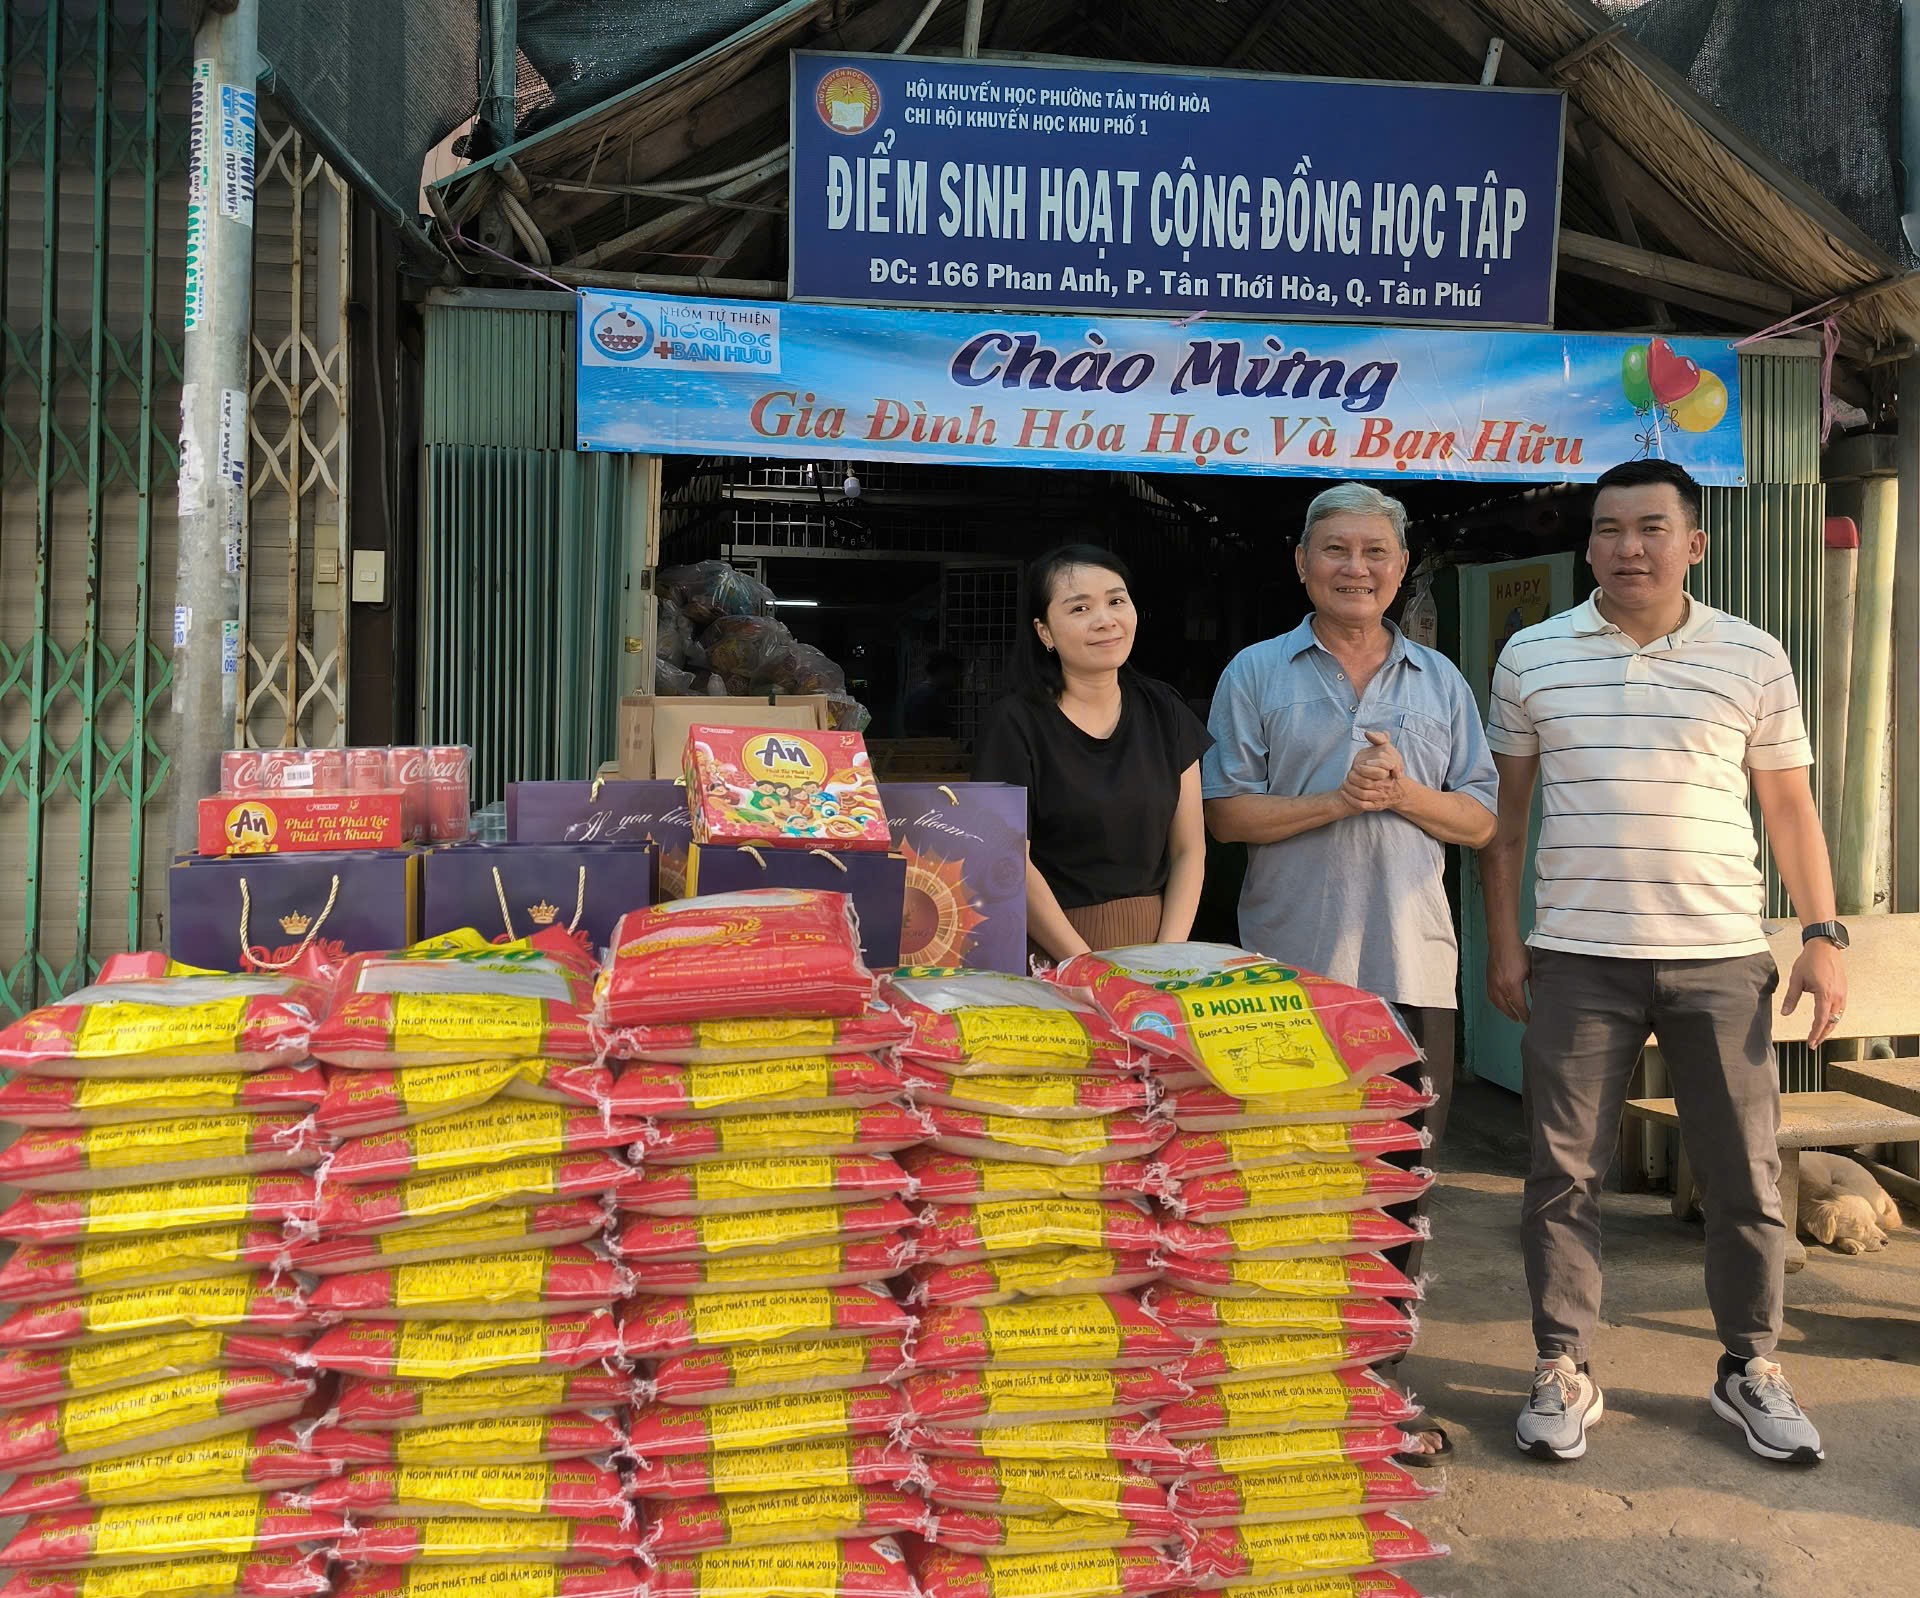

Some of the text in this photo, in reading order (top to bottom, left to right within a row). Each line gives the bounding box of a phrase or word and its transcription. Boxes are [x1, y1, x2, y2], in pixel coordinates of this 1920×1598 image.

[906, 78, 1210, 113] HỘI KHUYẾN HỌC PHƯỜNG TÂN THỚI HÒA
[904, 106, 1148, 135] CHI HỘI KHUYẾN HỌC KHU PHỐ 1
[826, 127, 1527, 275] ĐIỂM SINH HOẠT CỘNG ĐỒNG HỌC TẬP
[869, 257, 1481, 307] ĐC: 166 Phan Anh, P. Tân Thới Hòa, Q. Tân Phú
[660, 306, 702, 319] NHÓM
[730, 311, 771, 326] THIỆN
[671, 341, 721, 362] BẠN
[951, 333, 1398, 413] Chào Mừng
[749, 391, 1584, 471] Gia Đình Hóa Học Và Bạn Hữu
[1496, 578, 1541, 600] HAPPY
[755, 737, 811, 767] An
[230, 809, 270, 838] An
[604, 813, 653, 837] you
[658, 805, 692, 827] bloo
[886, 808, 972, 837] ou bloom
[343, 828, 383, 843] Khang
[1191, 1001, 1204, 1018] 8
[539, 1110, 559, 1119] 2019
[1097, 1326, 1115, 1334] 2019
[823, 1394, 841, 1403] 2019
[524, 1471, 544, 1481] 2019
[1341, 1471, 1358, 1480] 2019
[817, 1560, 836, 1569] 2019
[1097, 1558, 1114, 1567] 2019
